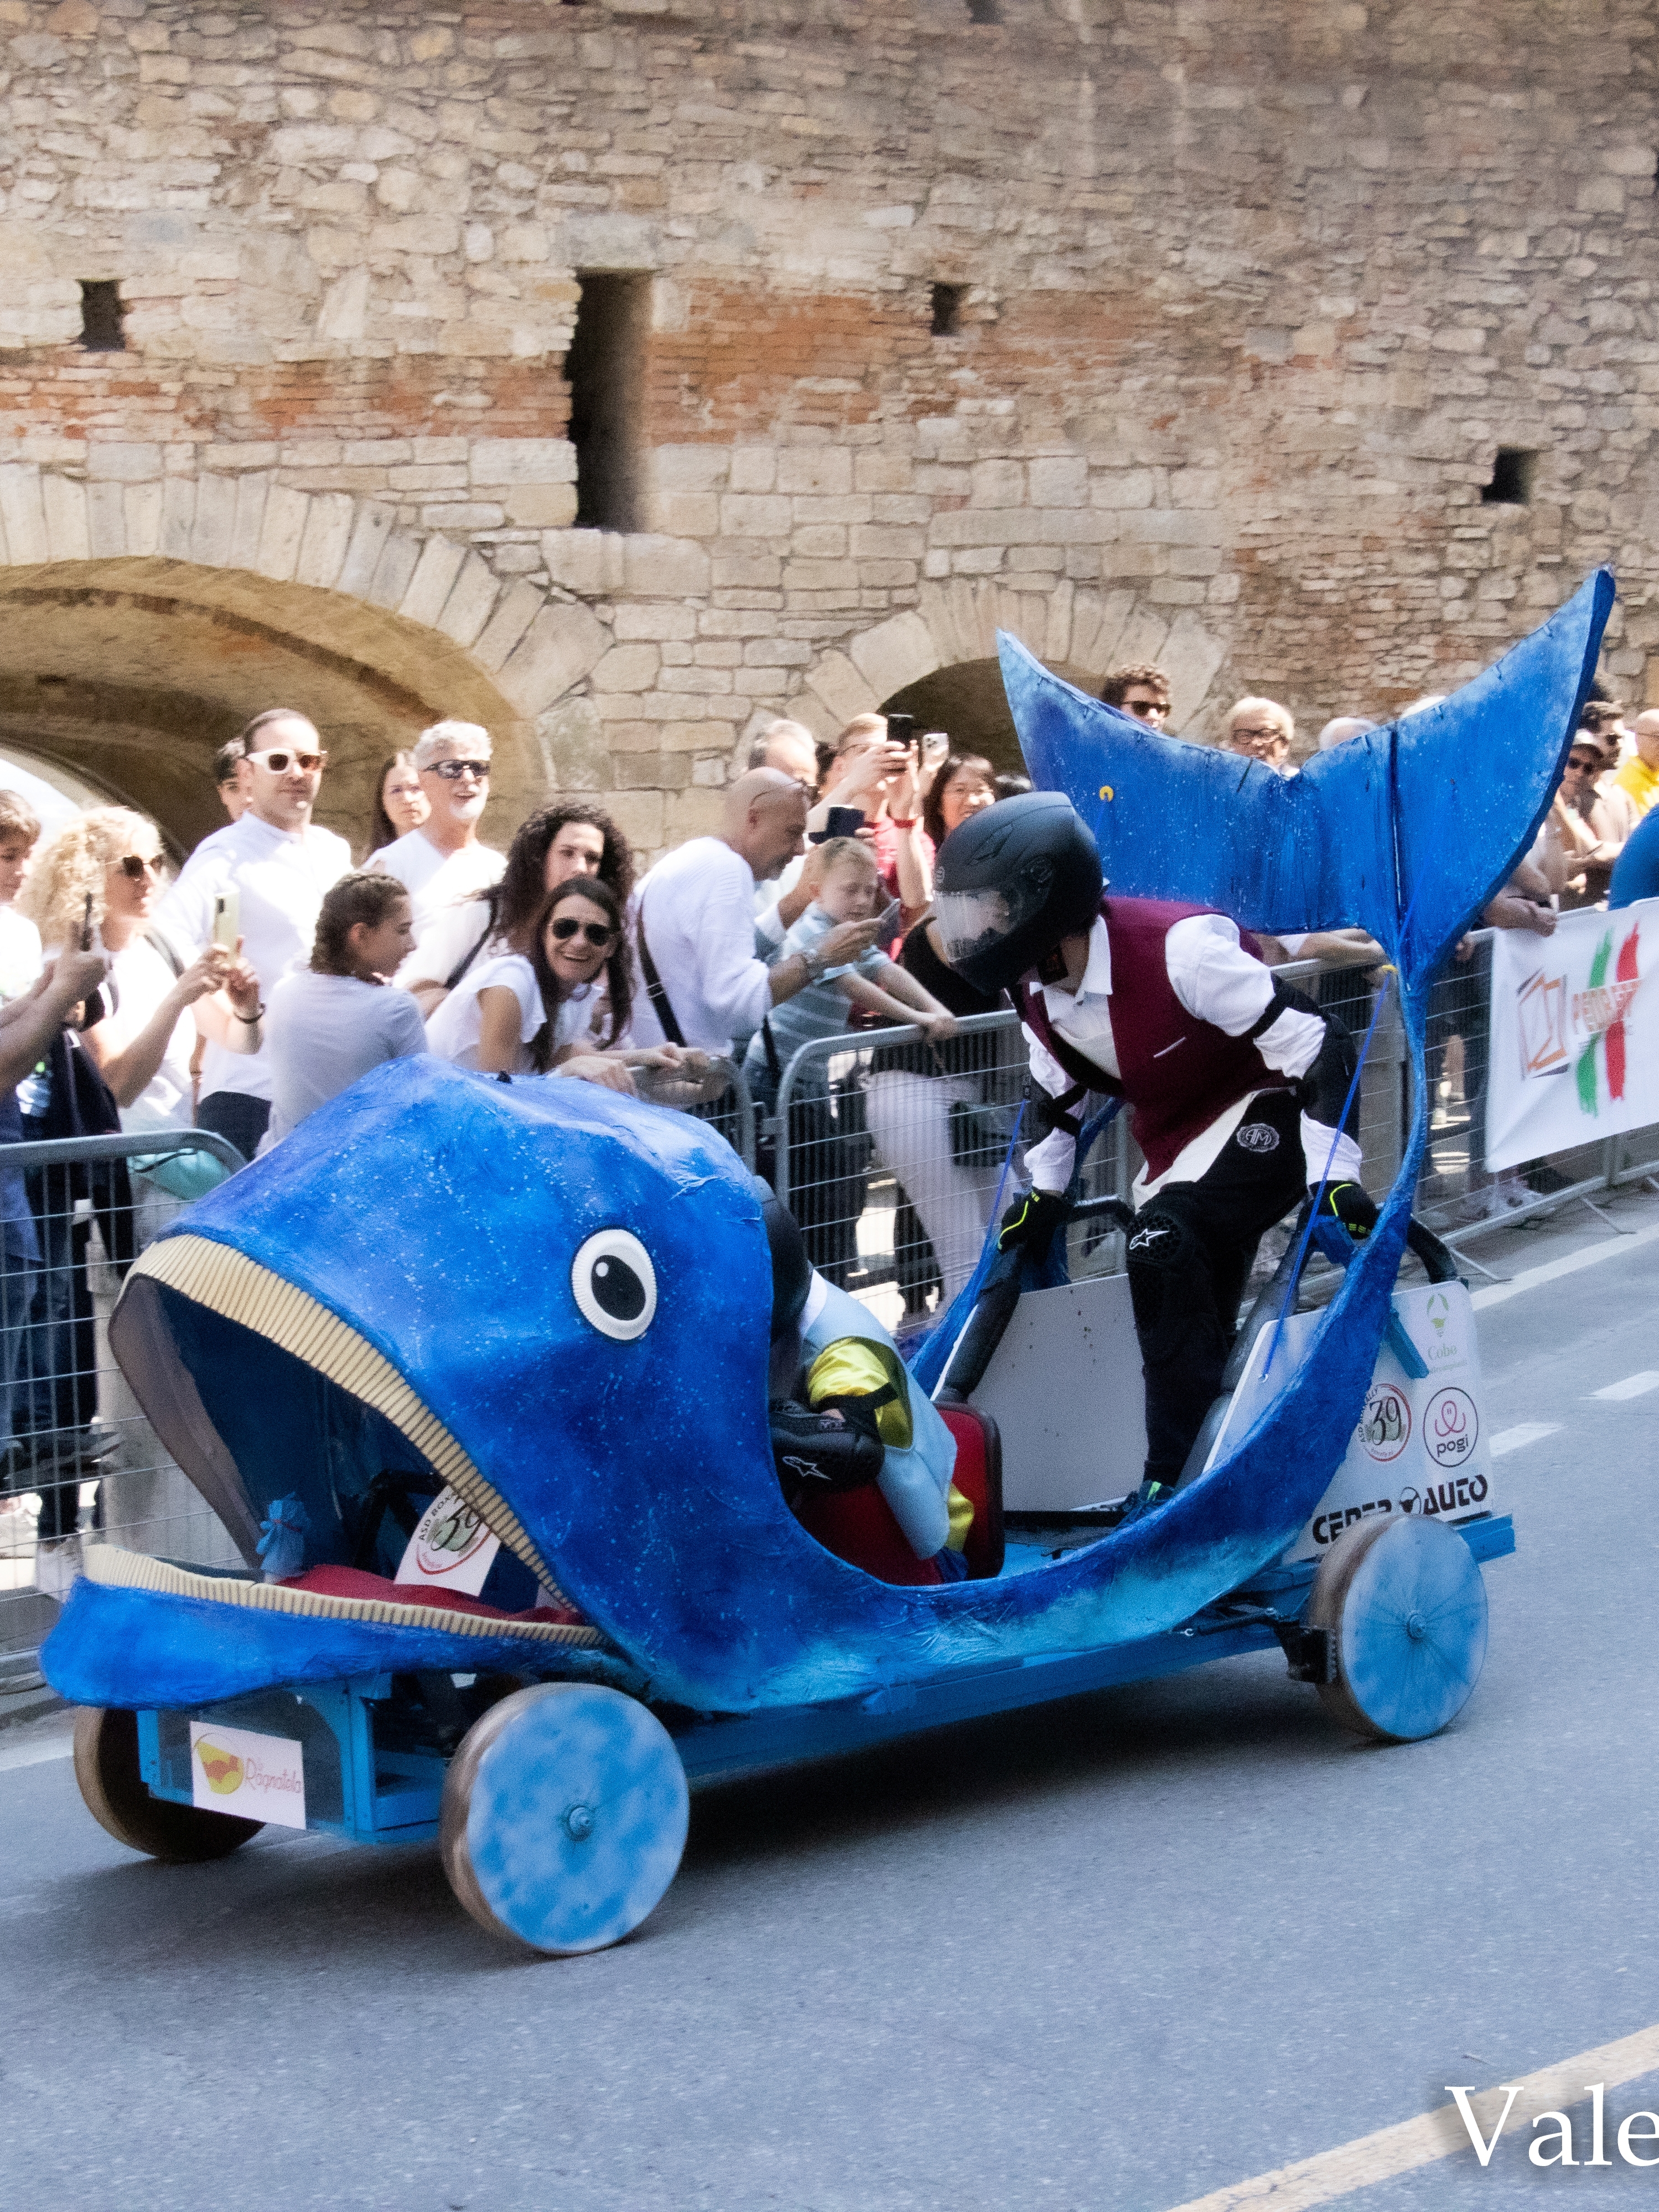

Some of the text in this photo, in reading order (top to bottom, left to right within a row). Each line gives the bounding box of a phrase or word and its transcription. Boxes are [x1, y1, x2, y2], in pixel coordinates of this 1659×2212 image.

[1369, 1396, 1402, 1445] 39
[1436, 1434, 1469, 1457] pogi
[1423, 1474, 1488, 1515] AUTO
[418, 1519, 432, 1540] ASD
